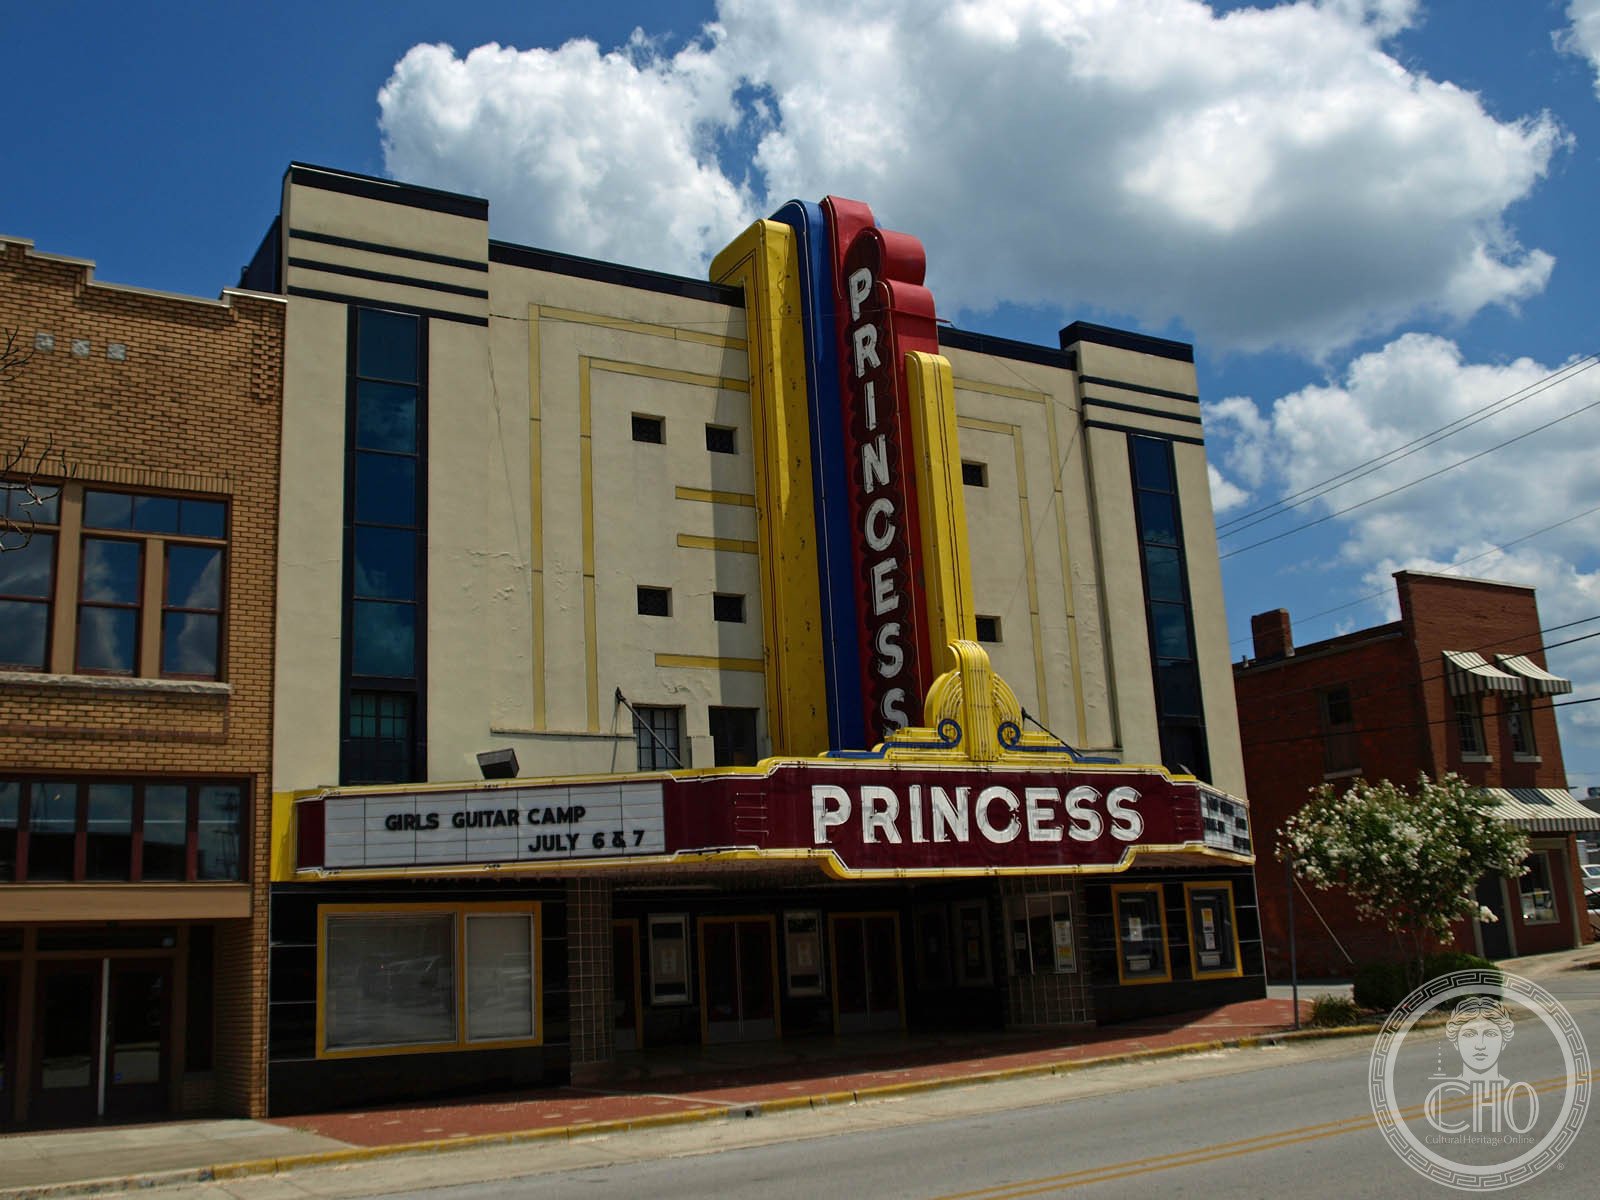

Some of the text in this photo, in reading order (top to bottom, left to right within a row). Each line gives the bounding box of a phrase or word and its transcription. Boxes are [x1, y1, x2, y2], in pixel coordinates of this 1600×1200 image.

[848, 266, 910, 737] PRINCESS
[385, 805, 586, 831] GIRLS GUITAR CAMP
[811, 784, 1145, 845] PRINCESS
[528, 829, 645, 852] JULY 6 & 7
